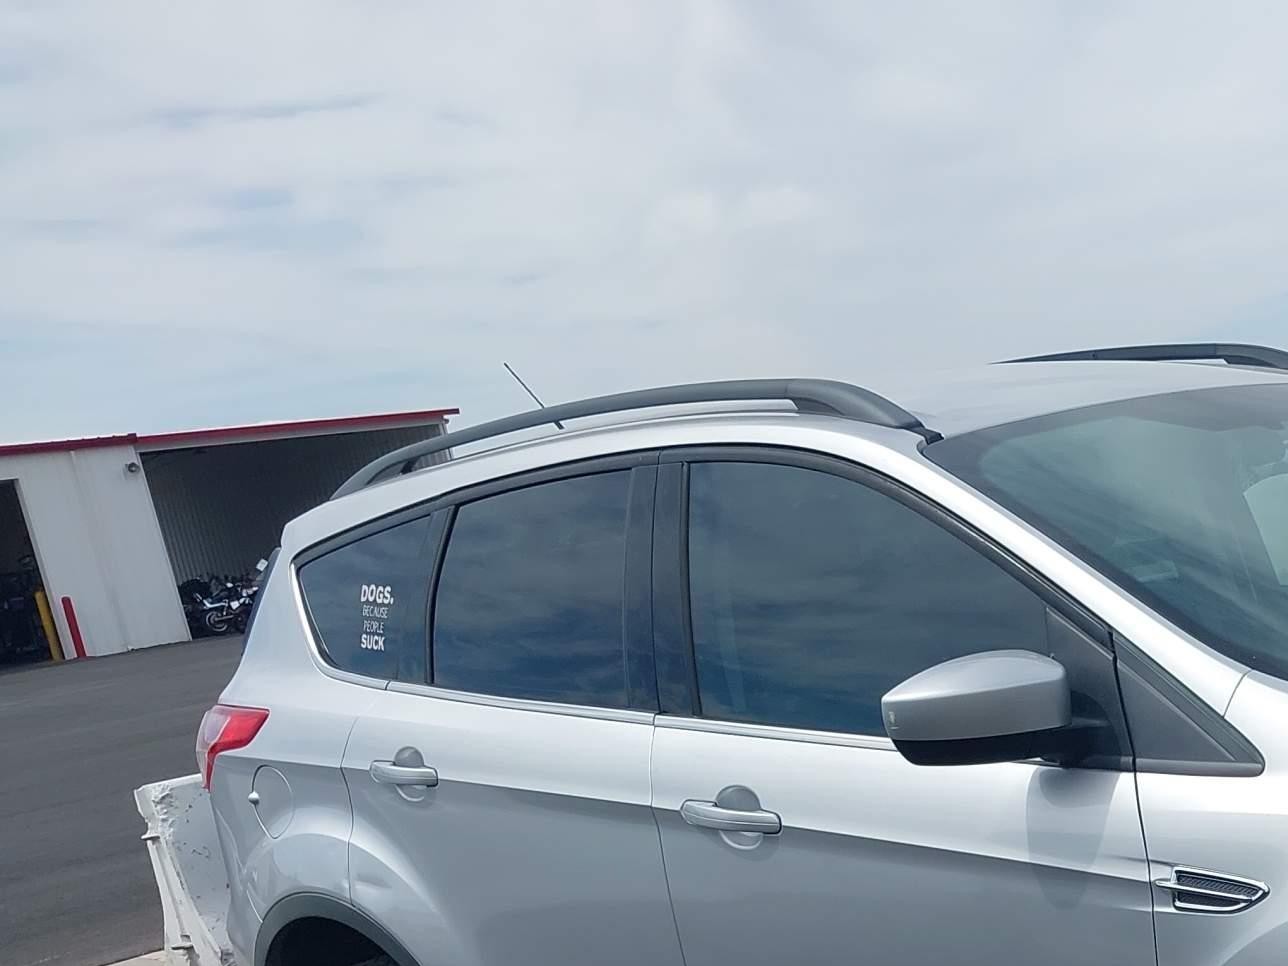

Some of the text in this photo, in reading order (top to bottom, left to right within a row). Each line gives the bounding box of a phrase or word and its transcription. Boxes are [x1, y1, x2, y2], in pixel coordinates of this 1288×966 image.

[362, 605, 388, 618] BECAUSE
[363, 620, 385, 633] PEOPLE
[360, 634, 385, 651] SUCK
